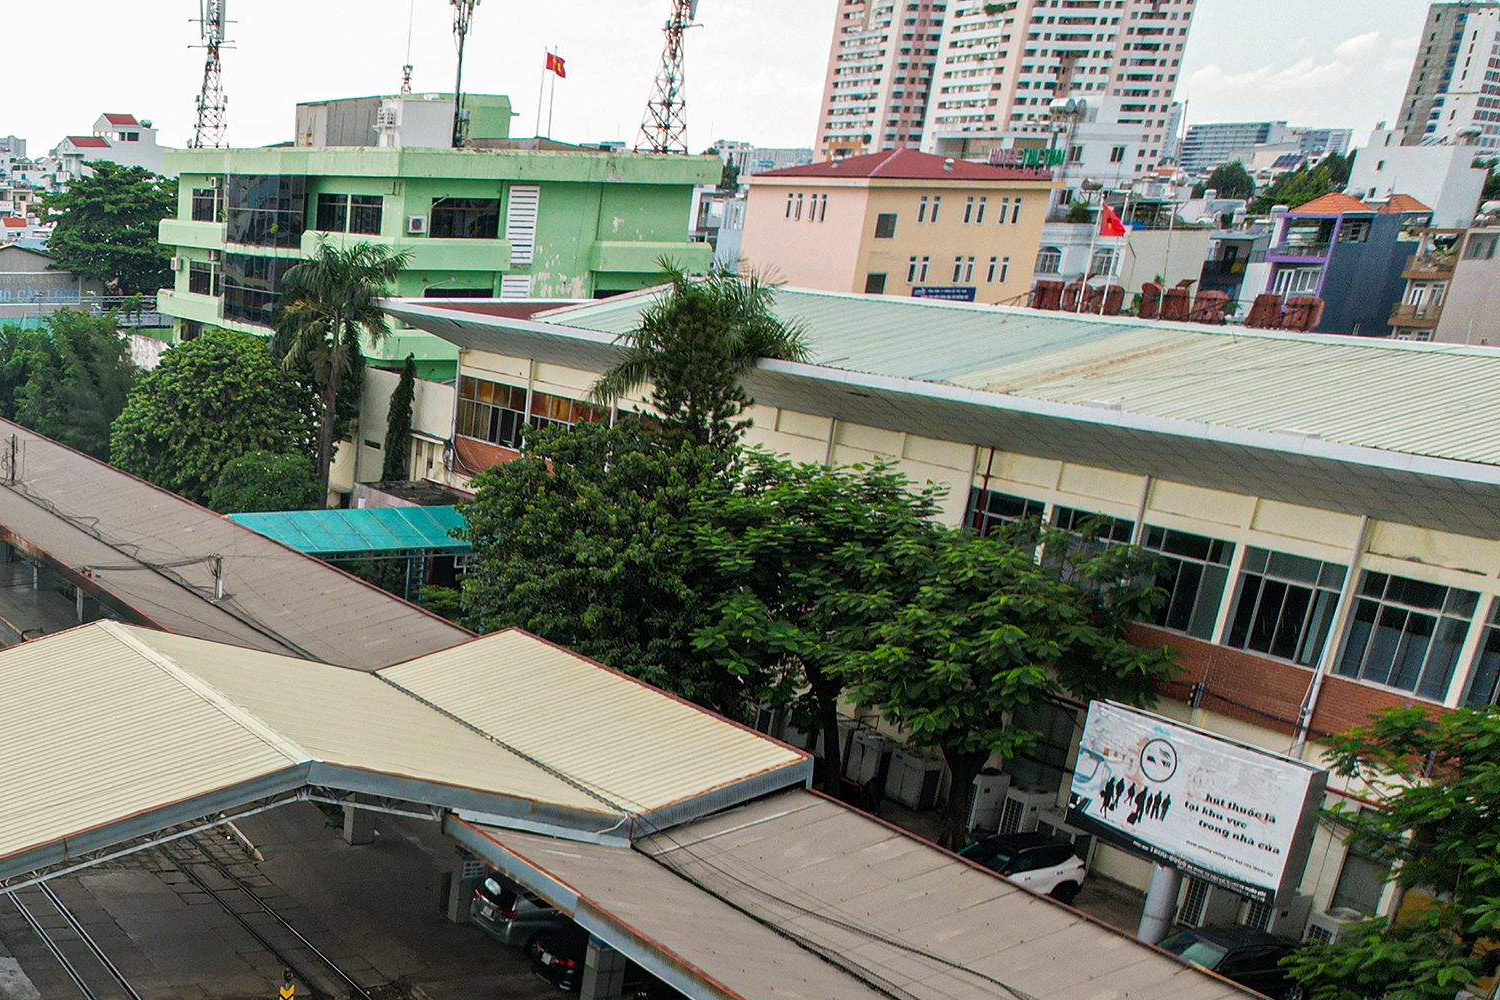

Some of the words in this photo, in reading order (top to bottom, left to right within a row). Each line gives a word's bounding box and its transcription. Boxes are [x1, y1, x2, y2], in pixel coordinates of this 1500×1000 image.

[1184, 800, 1200, 812] tại
[1201, 806, 1224, 821] khu
[1227, 801, 1263, 820] thuốc
[1198, 819, 1231, 839] trong
[1232, 833, 1255, 846] nhà
[1258, 842, 1281, 856] của
